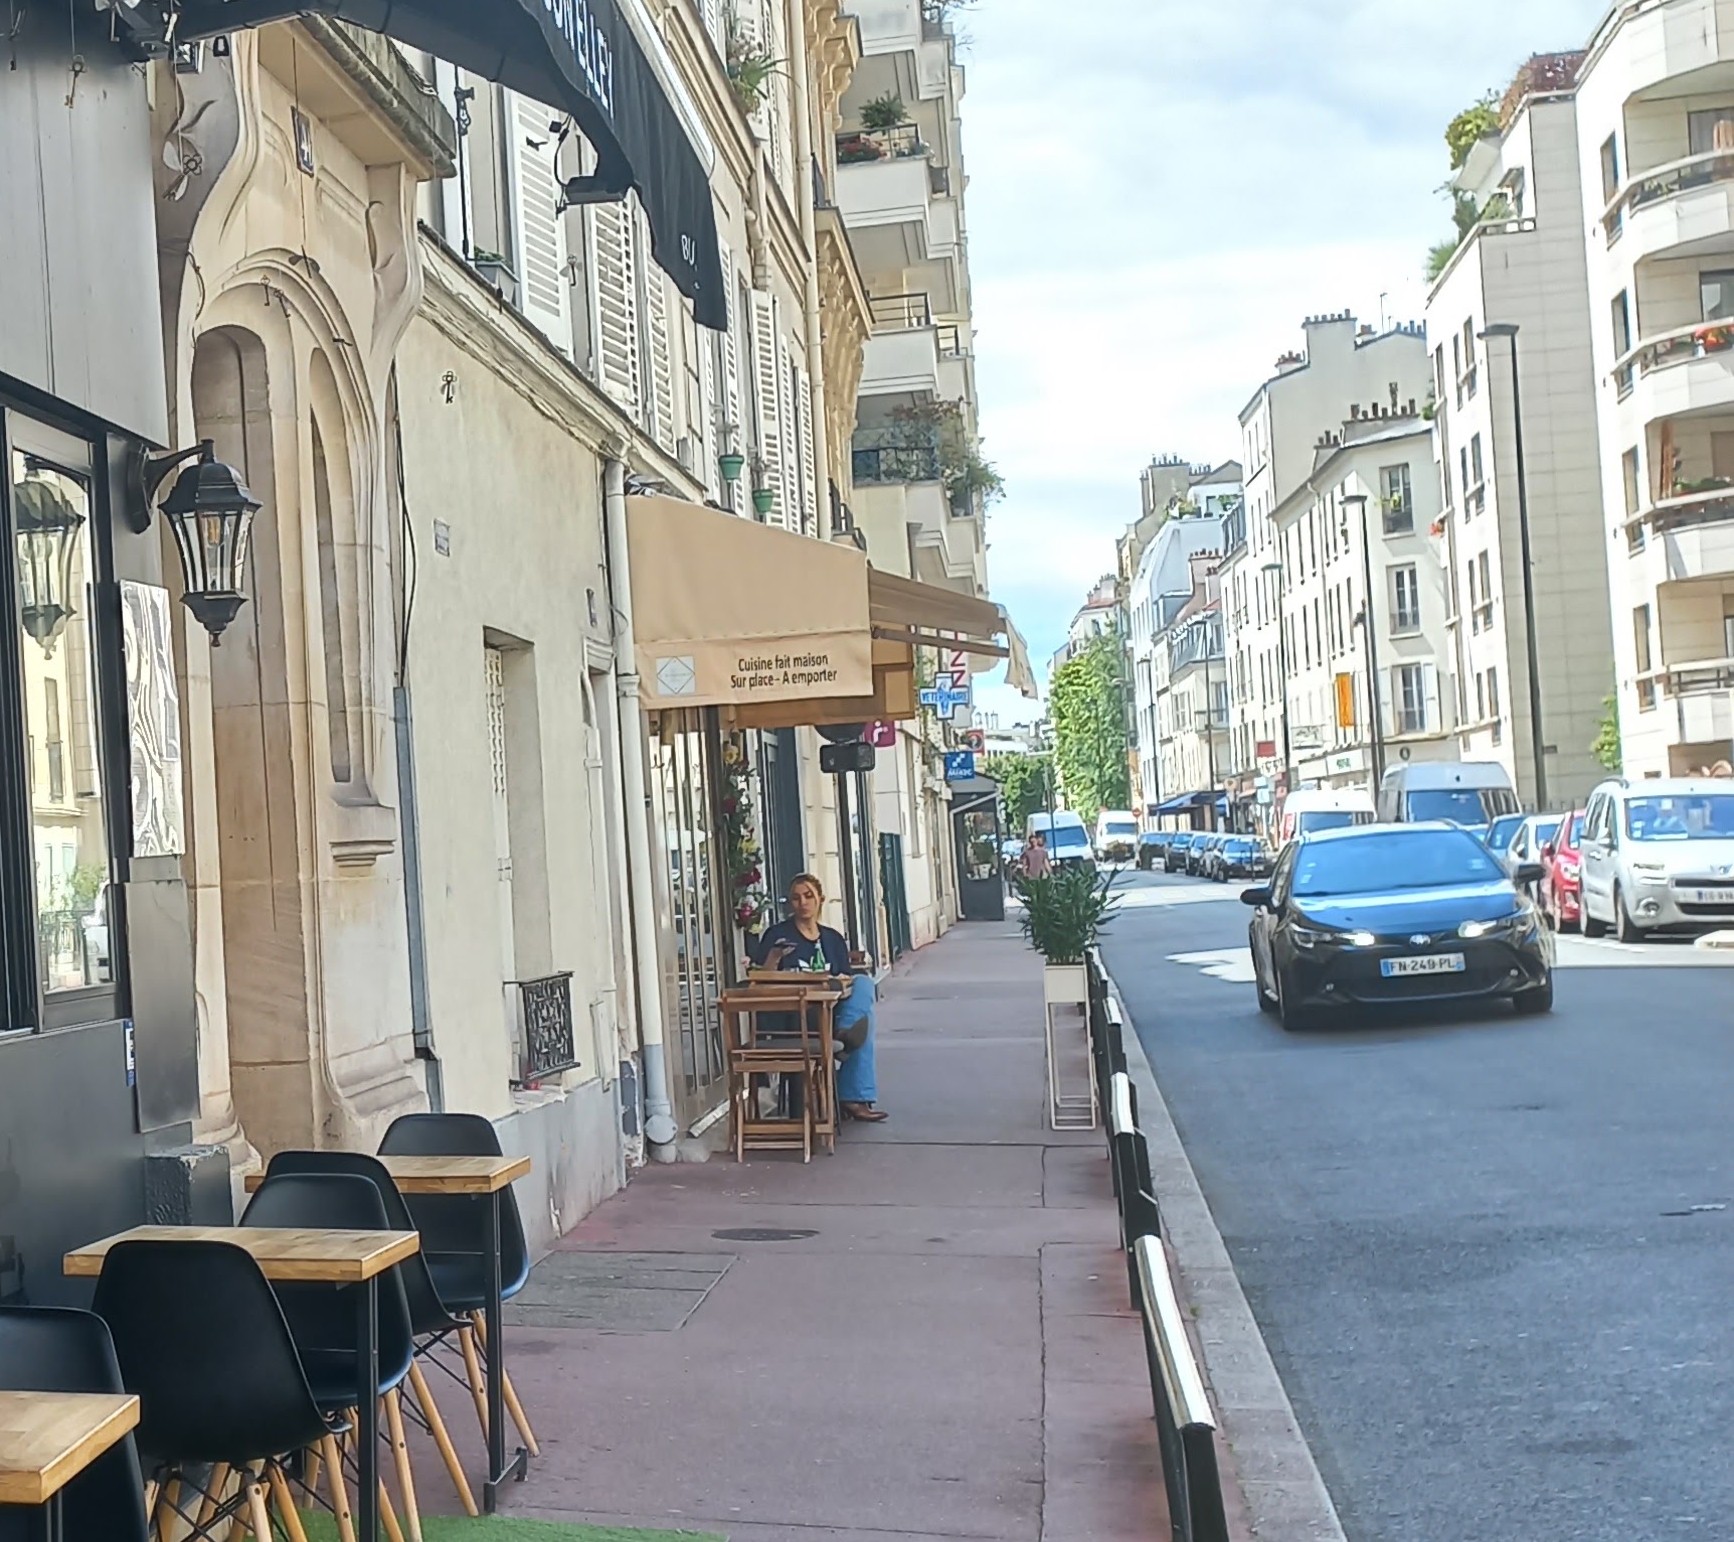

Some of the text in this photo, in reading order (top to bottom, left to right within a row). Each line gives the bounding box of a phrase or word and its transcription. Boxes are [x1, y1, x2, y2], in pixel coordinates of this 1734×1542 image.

[738, 652, 829, 673] Cuisine fait maison
[730, 674, 747, 689] Sur
[782, 671, 790, 685] A
[792, 670, 838, 687] emporter
